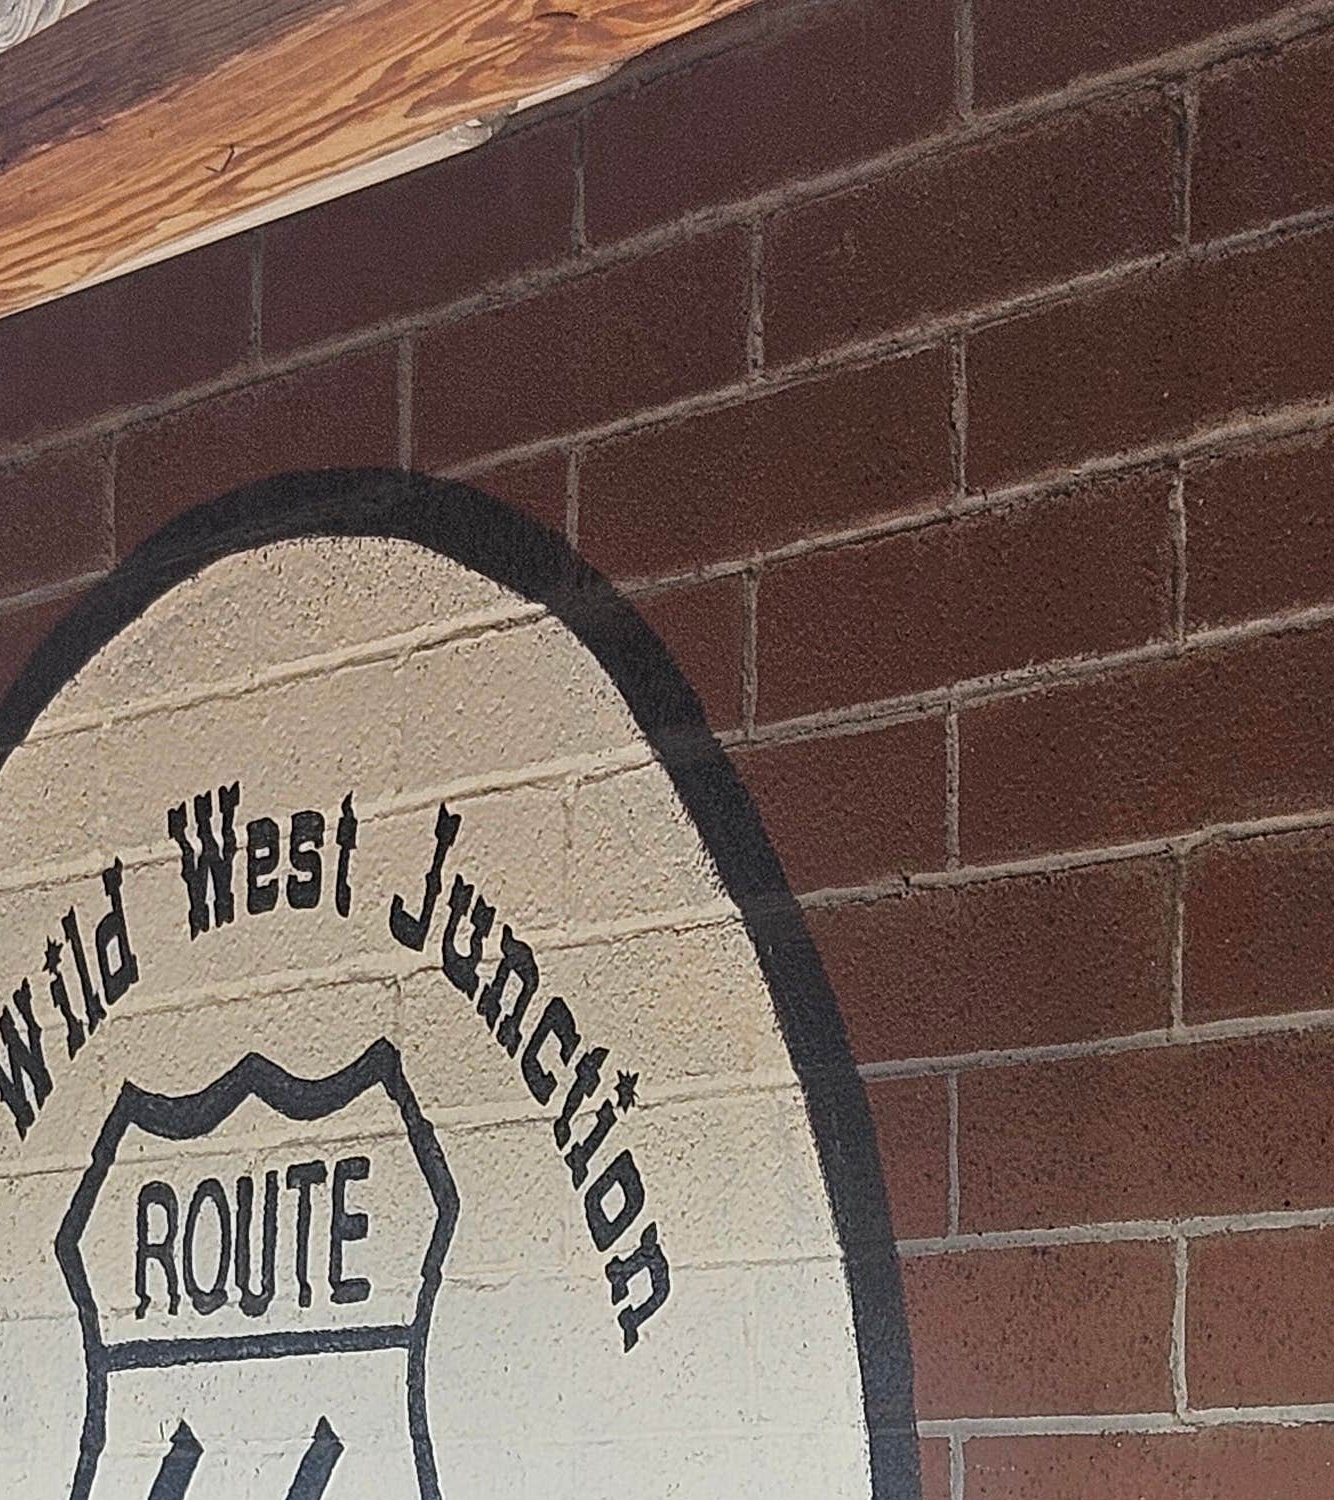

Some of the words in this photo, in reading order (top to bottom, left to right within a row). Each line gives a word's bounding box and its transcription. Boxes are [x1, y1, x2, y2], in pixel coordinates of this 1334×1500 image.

[134, 1155, 373, 1320] ROUTE
[167, 780, 359, 942] West
[388, 800, 671, 1354] Junction
